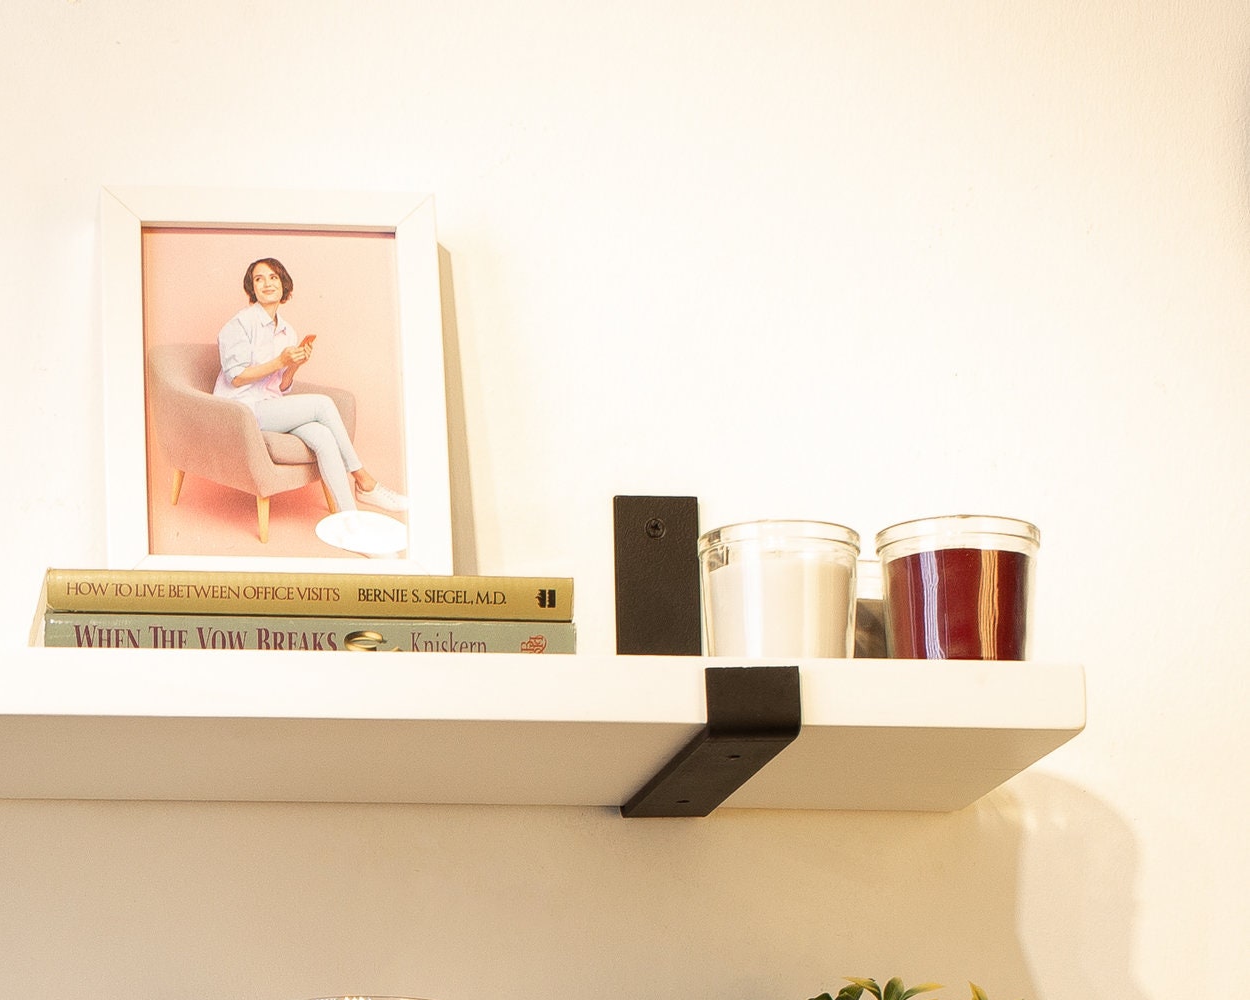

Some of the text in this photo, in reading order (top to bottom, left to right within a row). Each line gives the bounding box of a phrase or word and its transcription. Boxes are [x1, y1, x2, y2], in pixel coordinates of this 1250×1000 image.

[66, 582, 340, 601] HOW TO LIVE BETWEEN OFFICE VISITS
[357, 588, 507, 605] BERNIE S. SIEGEL, M.D.
[74, 624, 338, 651] WHEN THE VOW BREAKS
[410, 631, 487, 653] Kniskern
